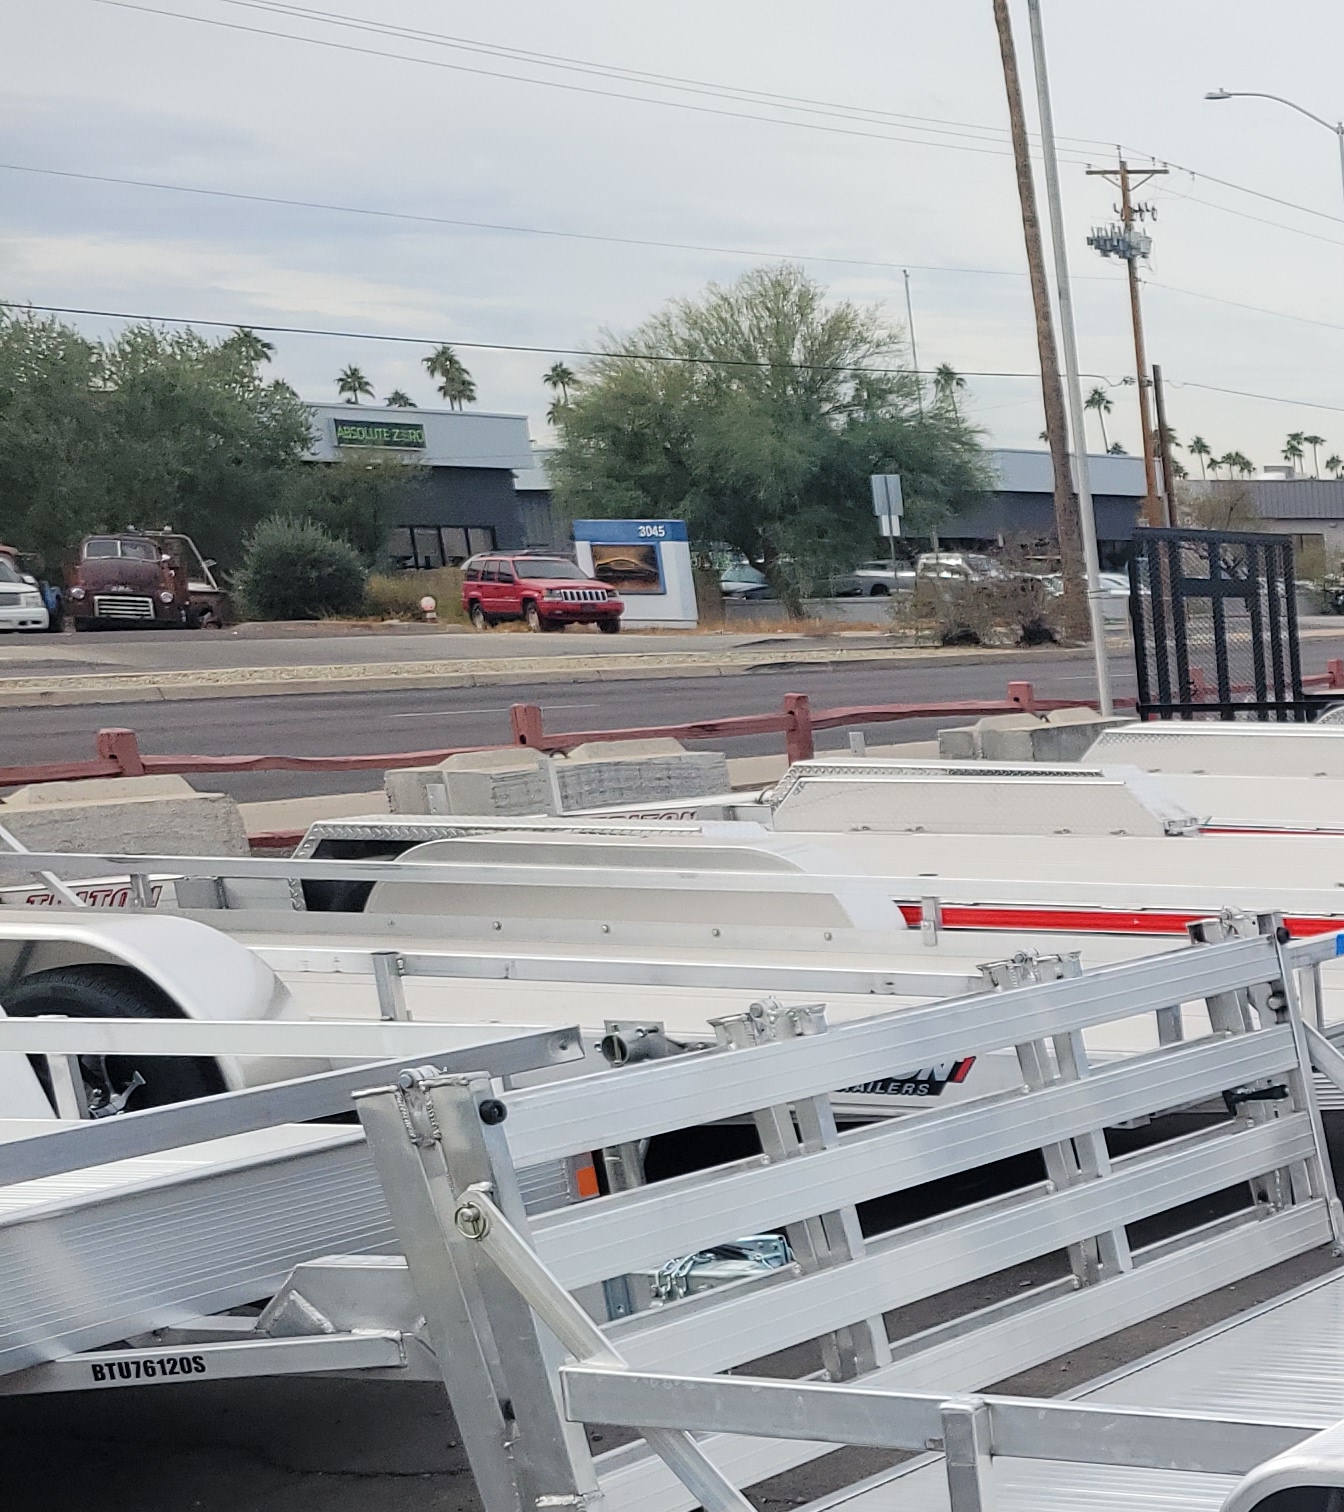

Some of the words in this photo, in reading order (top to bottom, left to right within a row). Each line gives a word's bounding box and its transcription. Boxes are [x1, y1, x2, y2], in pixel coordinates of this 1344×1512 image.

[337, 424, 391, 440] ABSOLUTE
[638, 524, 666, 538] 3045
[91, 1355, 206, 1382] BTU76120S
